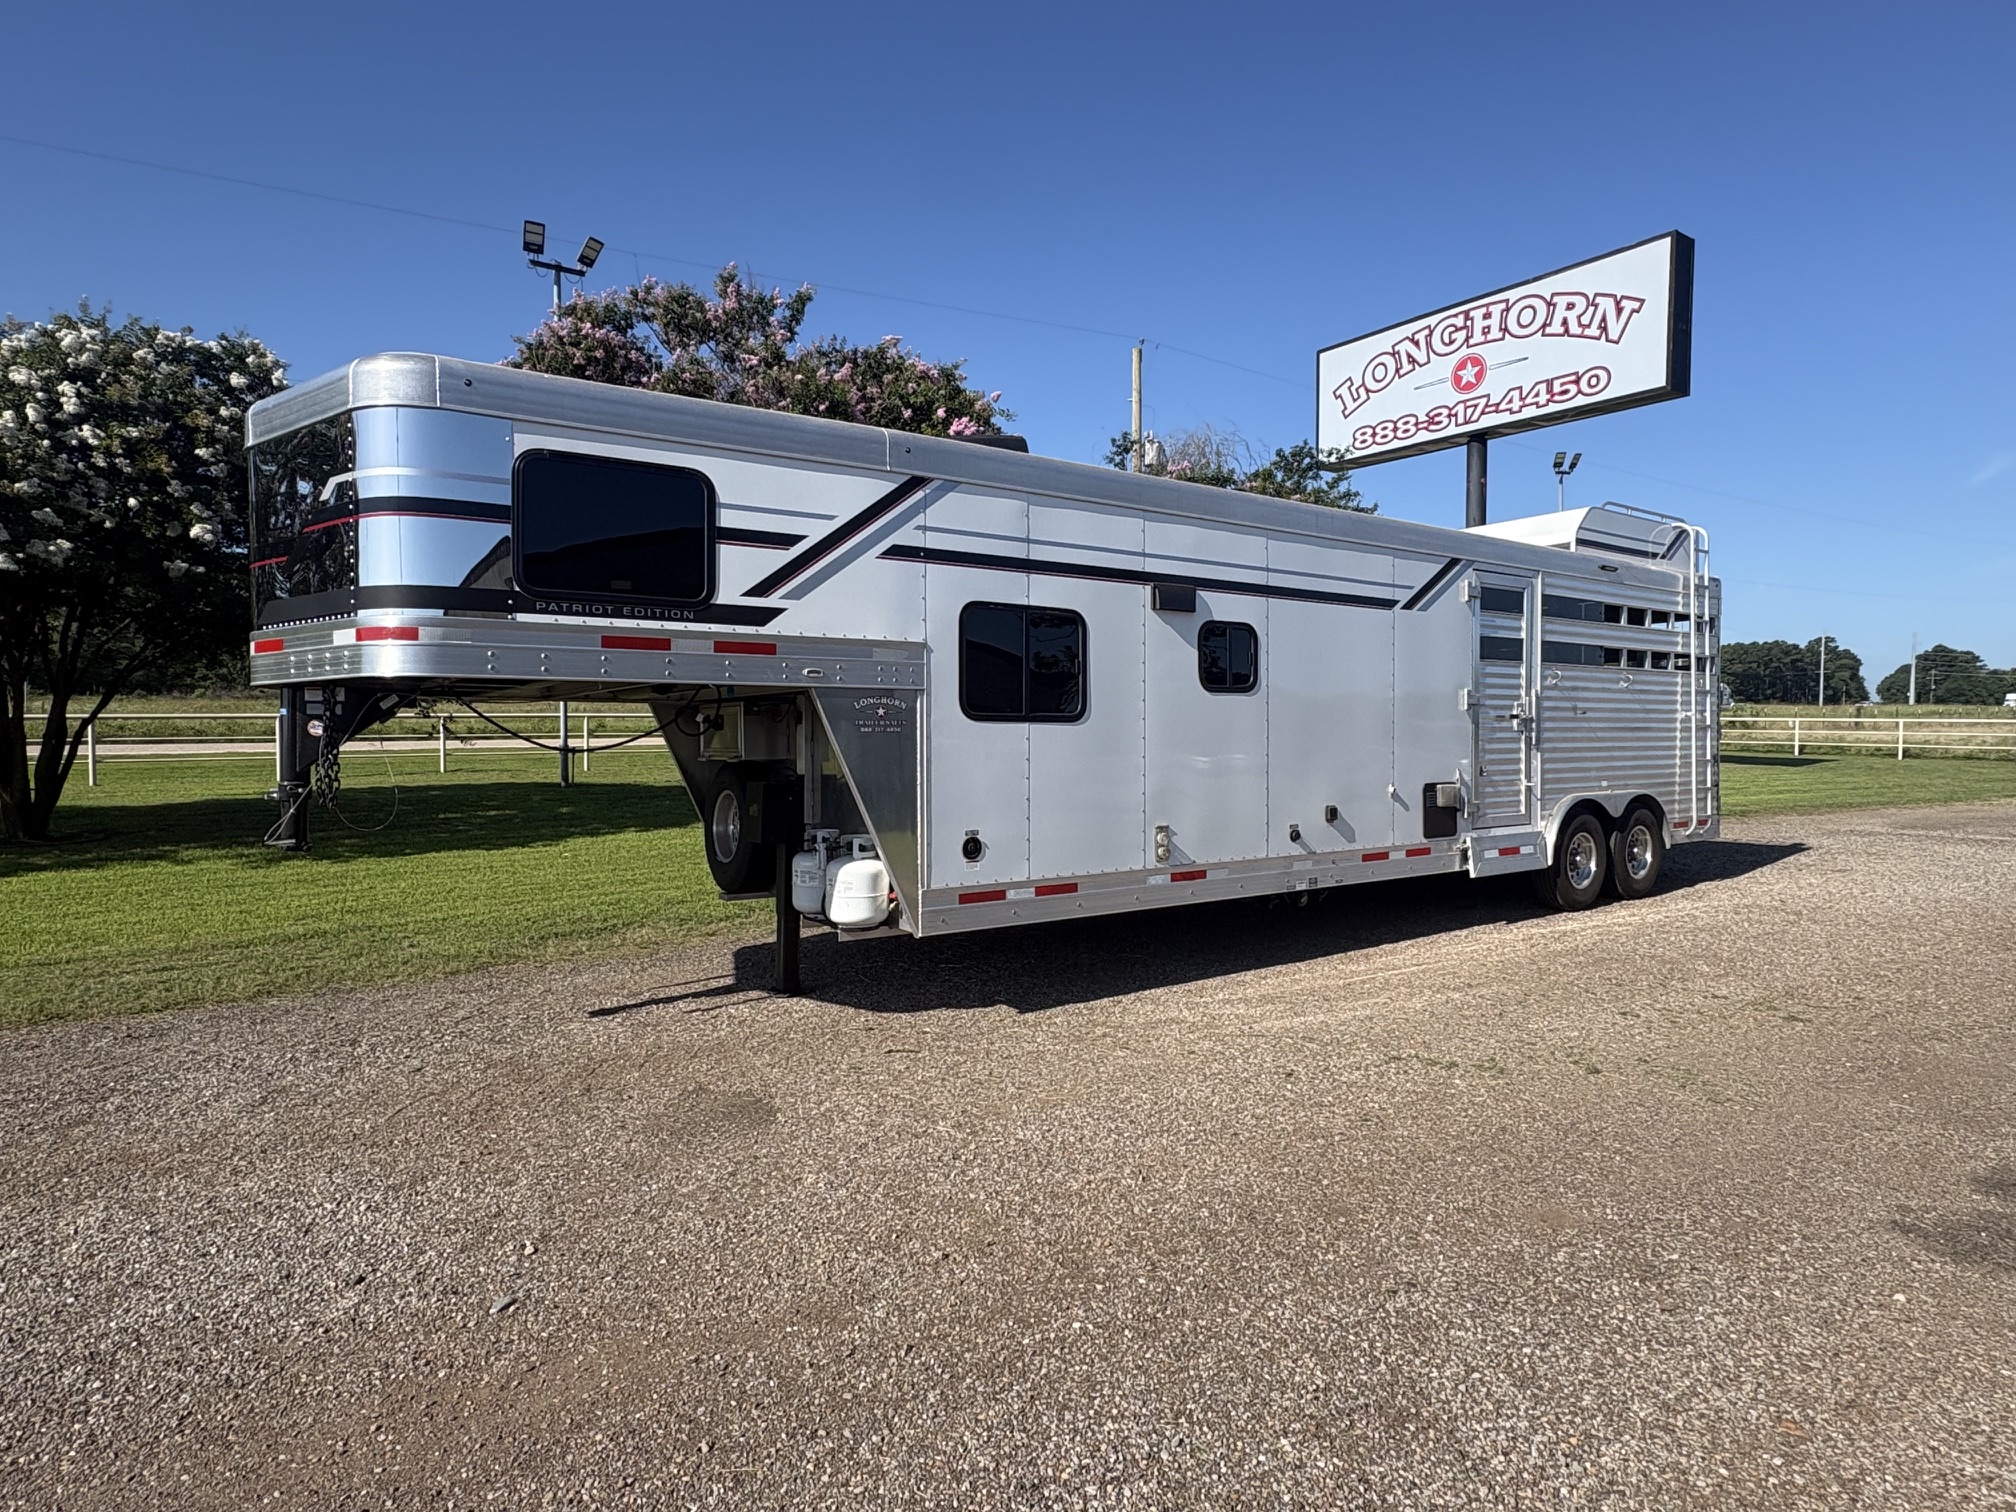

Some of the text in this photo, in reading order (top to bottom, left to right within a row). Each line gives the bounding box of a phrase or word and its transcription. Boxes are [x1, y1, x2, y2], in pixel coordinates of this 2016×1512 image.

[1334, 292, 1646, 419] LONGHORN
[1352, 366, 1611, 450] 888-317-4450
[536, 602, 694, 619] PATRIOT EDITION
[853, 696, 907, 710] LONGHORN
